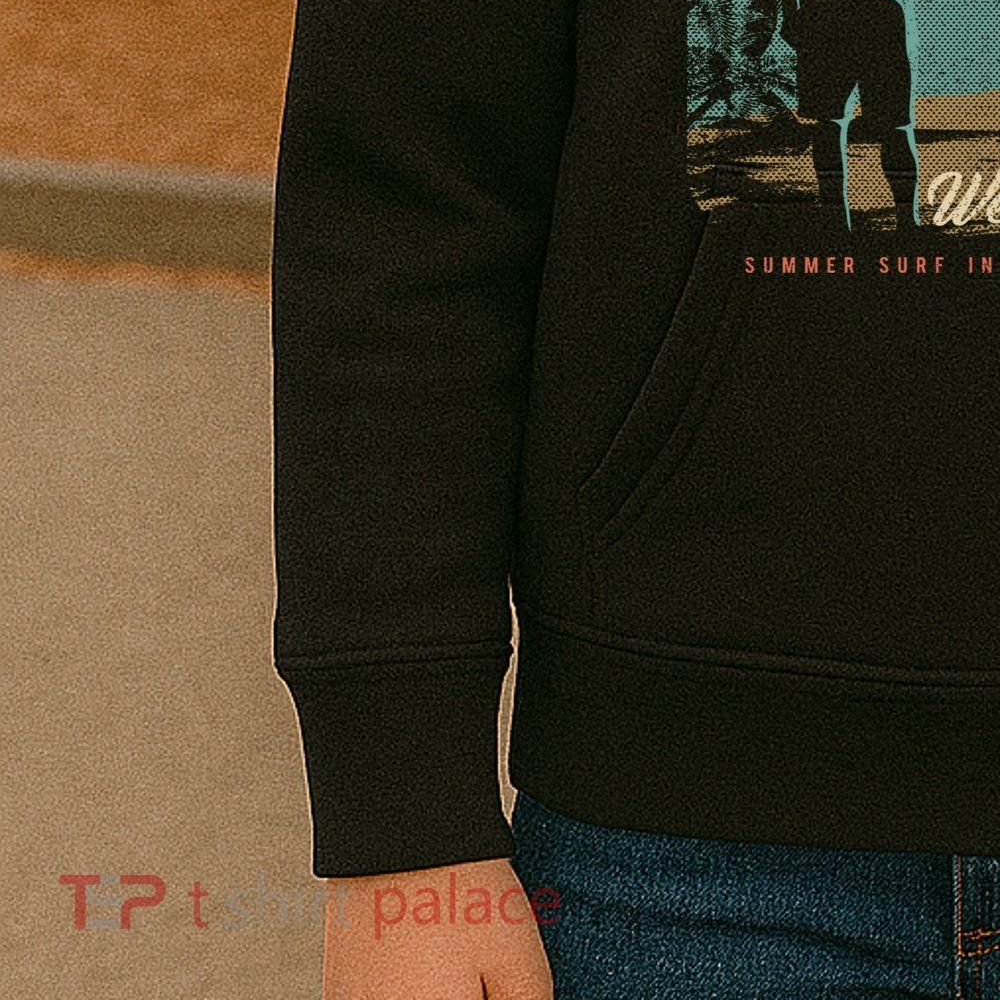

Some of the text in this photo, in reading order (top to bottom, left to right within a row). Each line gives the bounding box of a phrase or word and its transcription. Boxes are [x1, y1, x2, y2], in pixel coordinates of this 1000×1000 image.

[743, 256, 857, 275] SUMMER
[878, 256, 946, 275] SURF
[968, 256, 994, 275] IN
